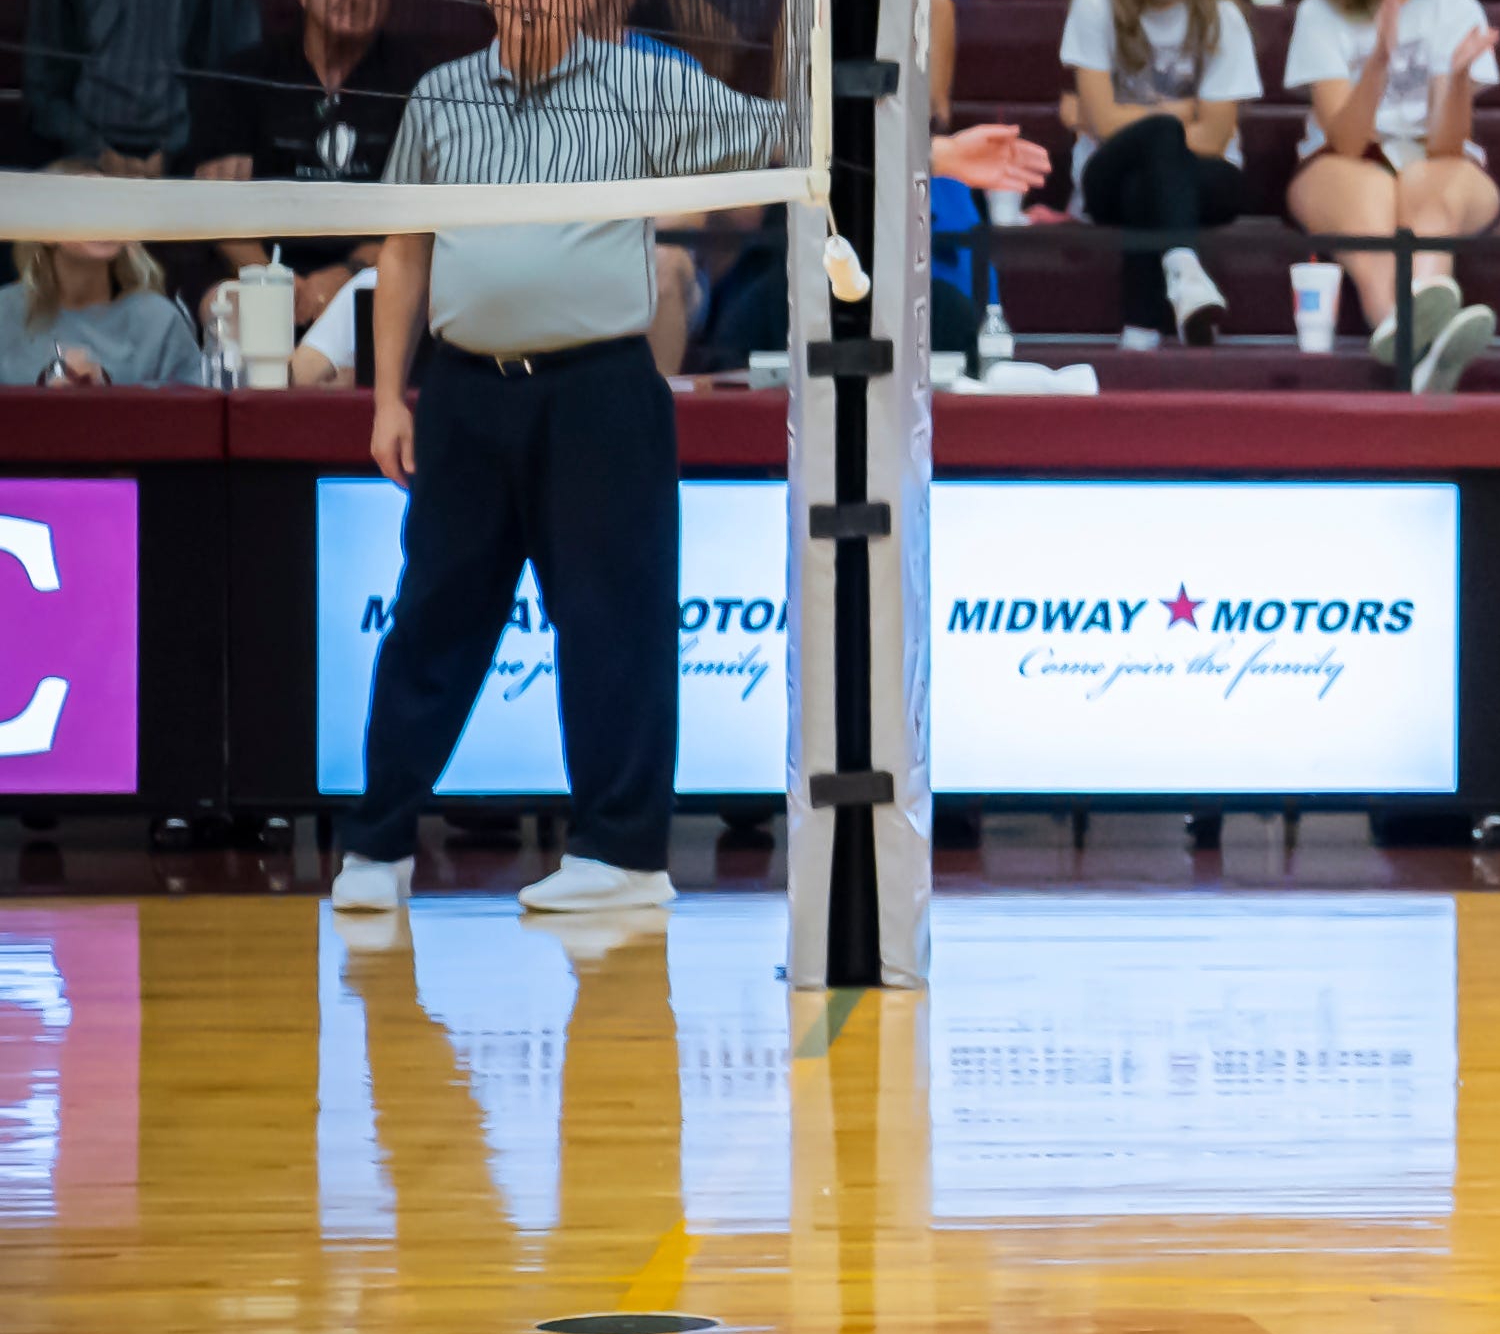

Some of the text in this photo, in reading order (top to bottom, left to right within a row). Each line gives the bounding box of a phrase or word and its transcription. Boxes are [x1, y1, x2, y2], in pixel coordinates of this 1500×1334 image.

[679, 597, 788, 634] OTO
[946, 598, 1416, 634] MIDWAY MOTORS
[680, 635, 769, 702] amily
[1018, 637, 1346, 701] Come join the family
